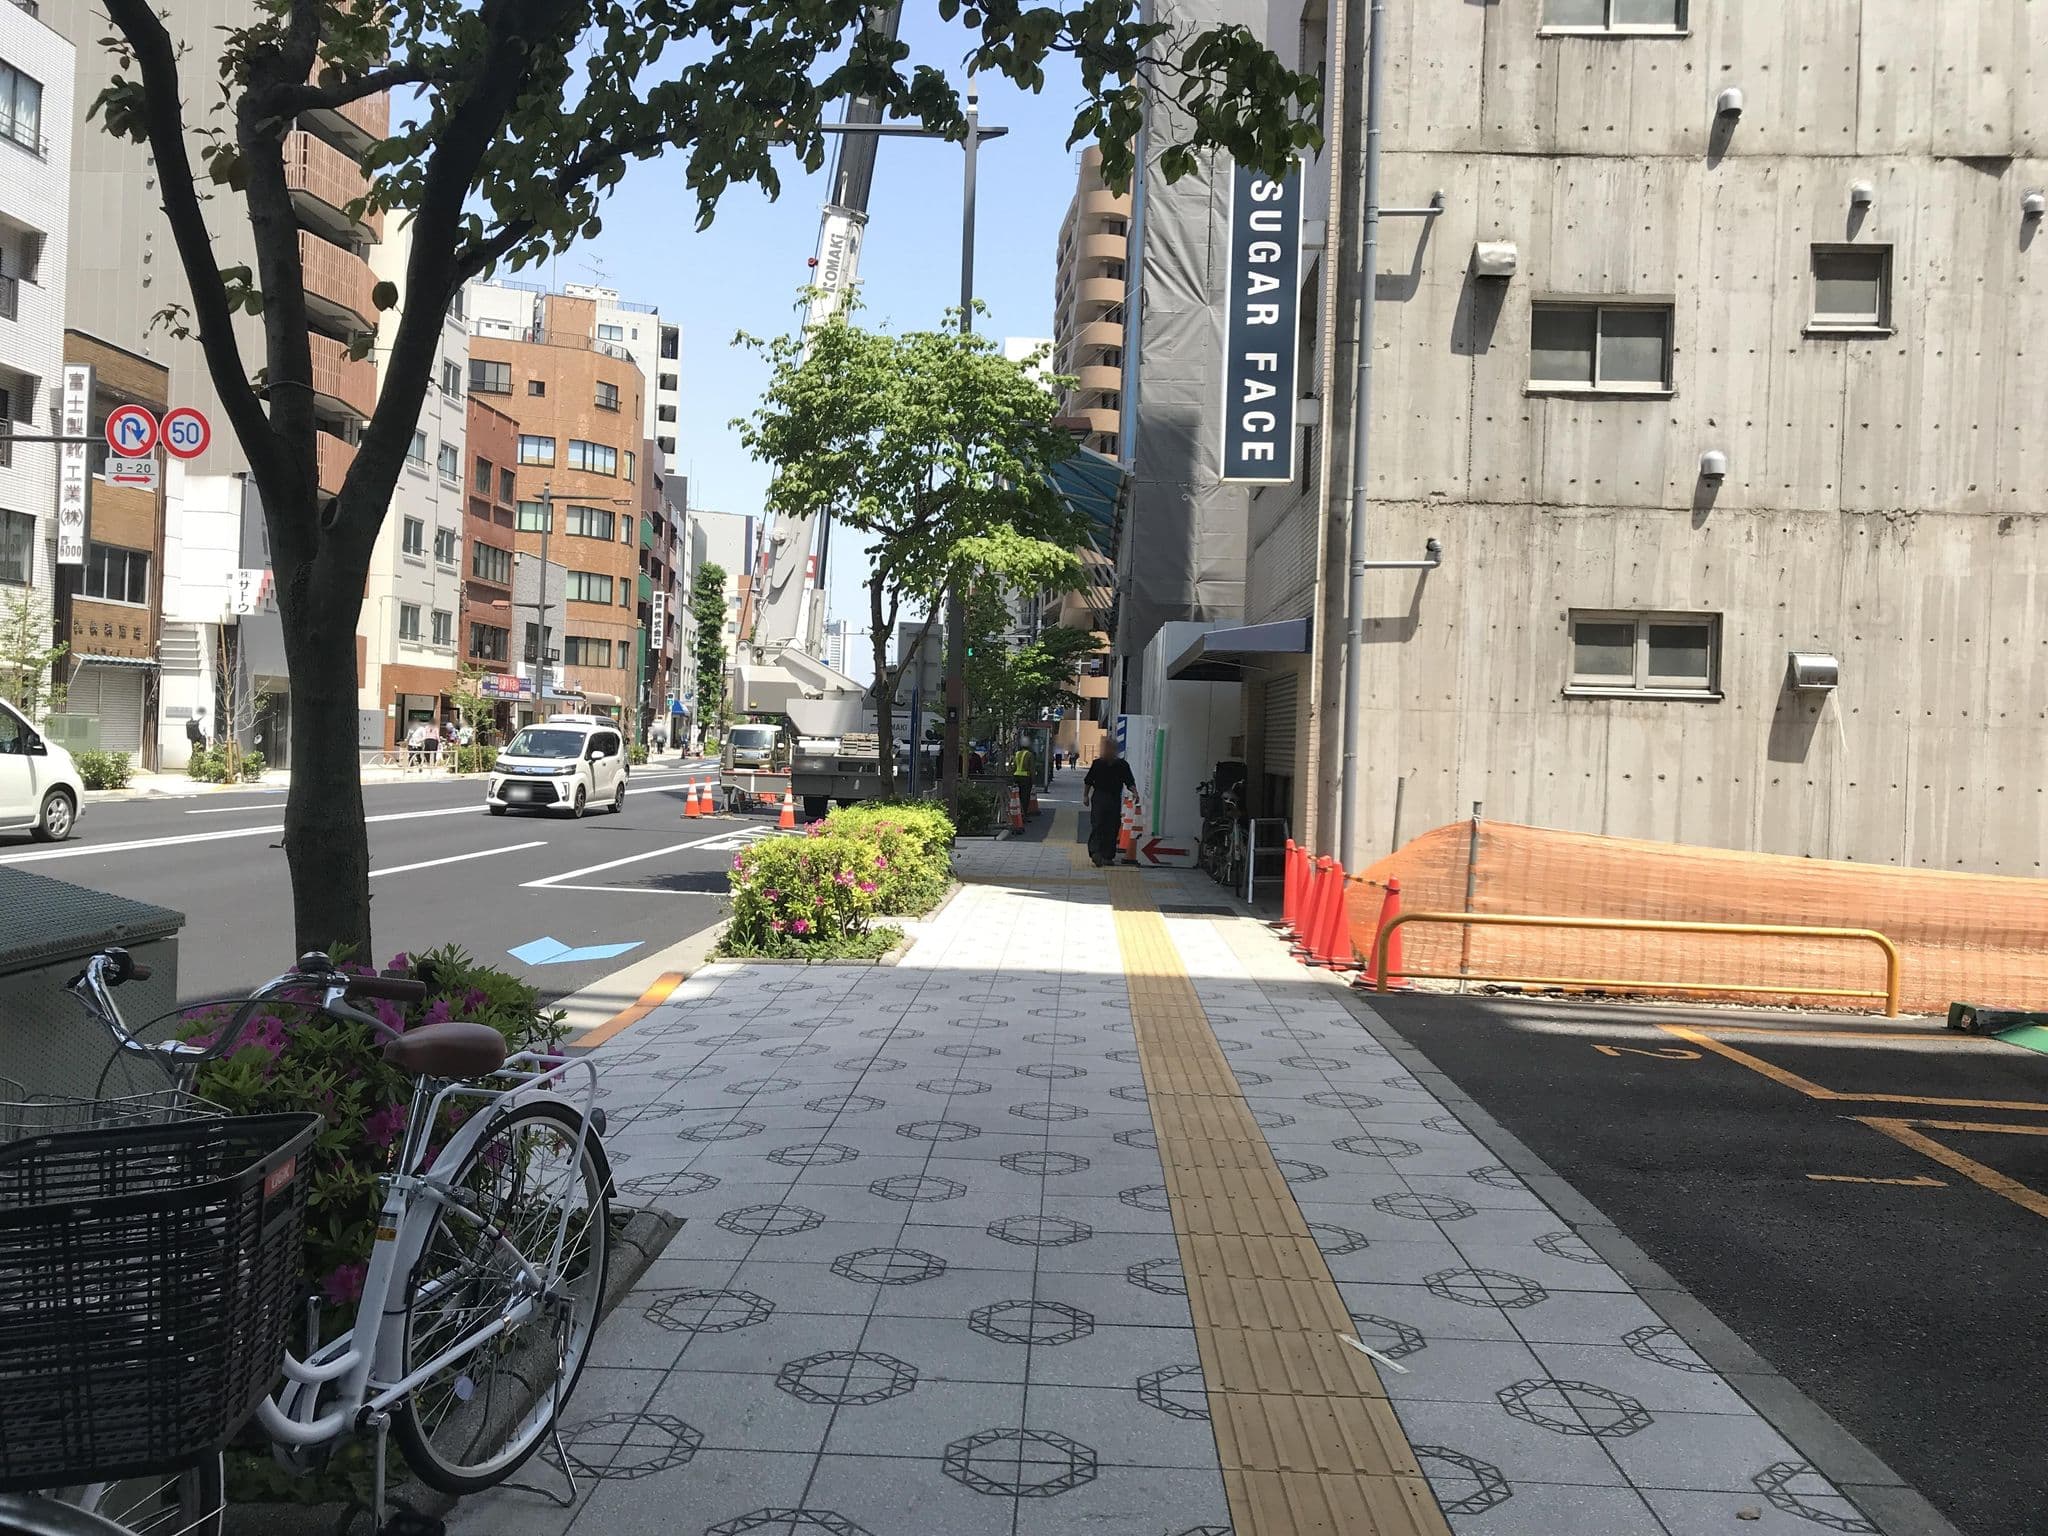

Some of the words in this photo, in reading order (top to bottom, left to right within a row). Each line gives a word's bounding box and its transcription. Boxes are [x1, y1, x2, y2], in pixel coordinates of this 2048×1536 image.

[1247, 180, 1283, 325] SUGAR
[172, 421, 200, 444] 50
[1241, 352, 1278, 461] FACE
[116, 462, 151, 474] 8-20
